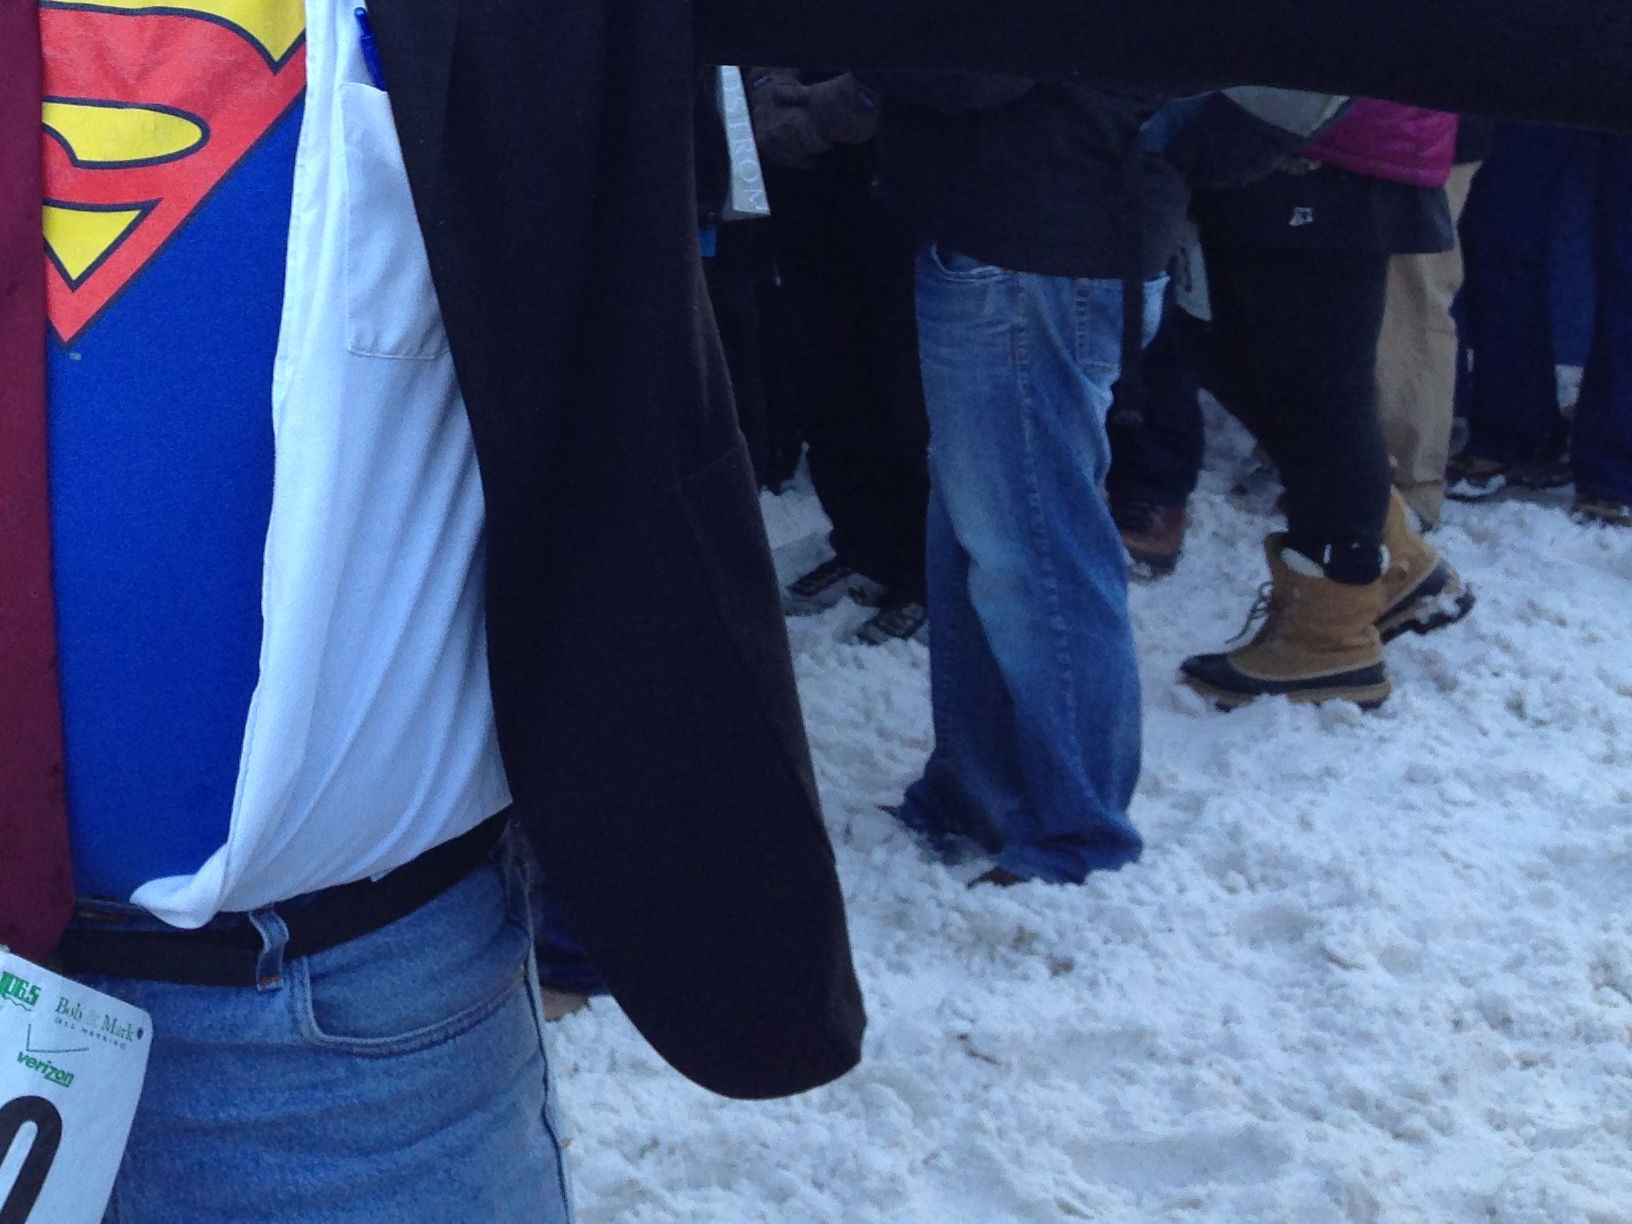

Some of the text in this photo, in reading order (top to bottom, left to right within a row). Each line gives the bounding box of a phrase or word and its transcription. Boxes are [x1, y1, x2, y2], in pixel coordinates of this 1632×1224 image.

[55, 986, 83, 1021] Bob
[101, 1013, 135, 1043] Mark
[16, 1050, 76, 1088] verizon
